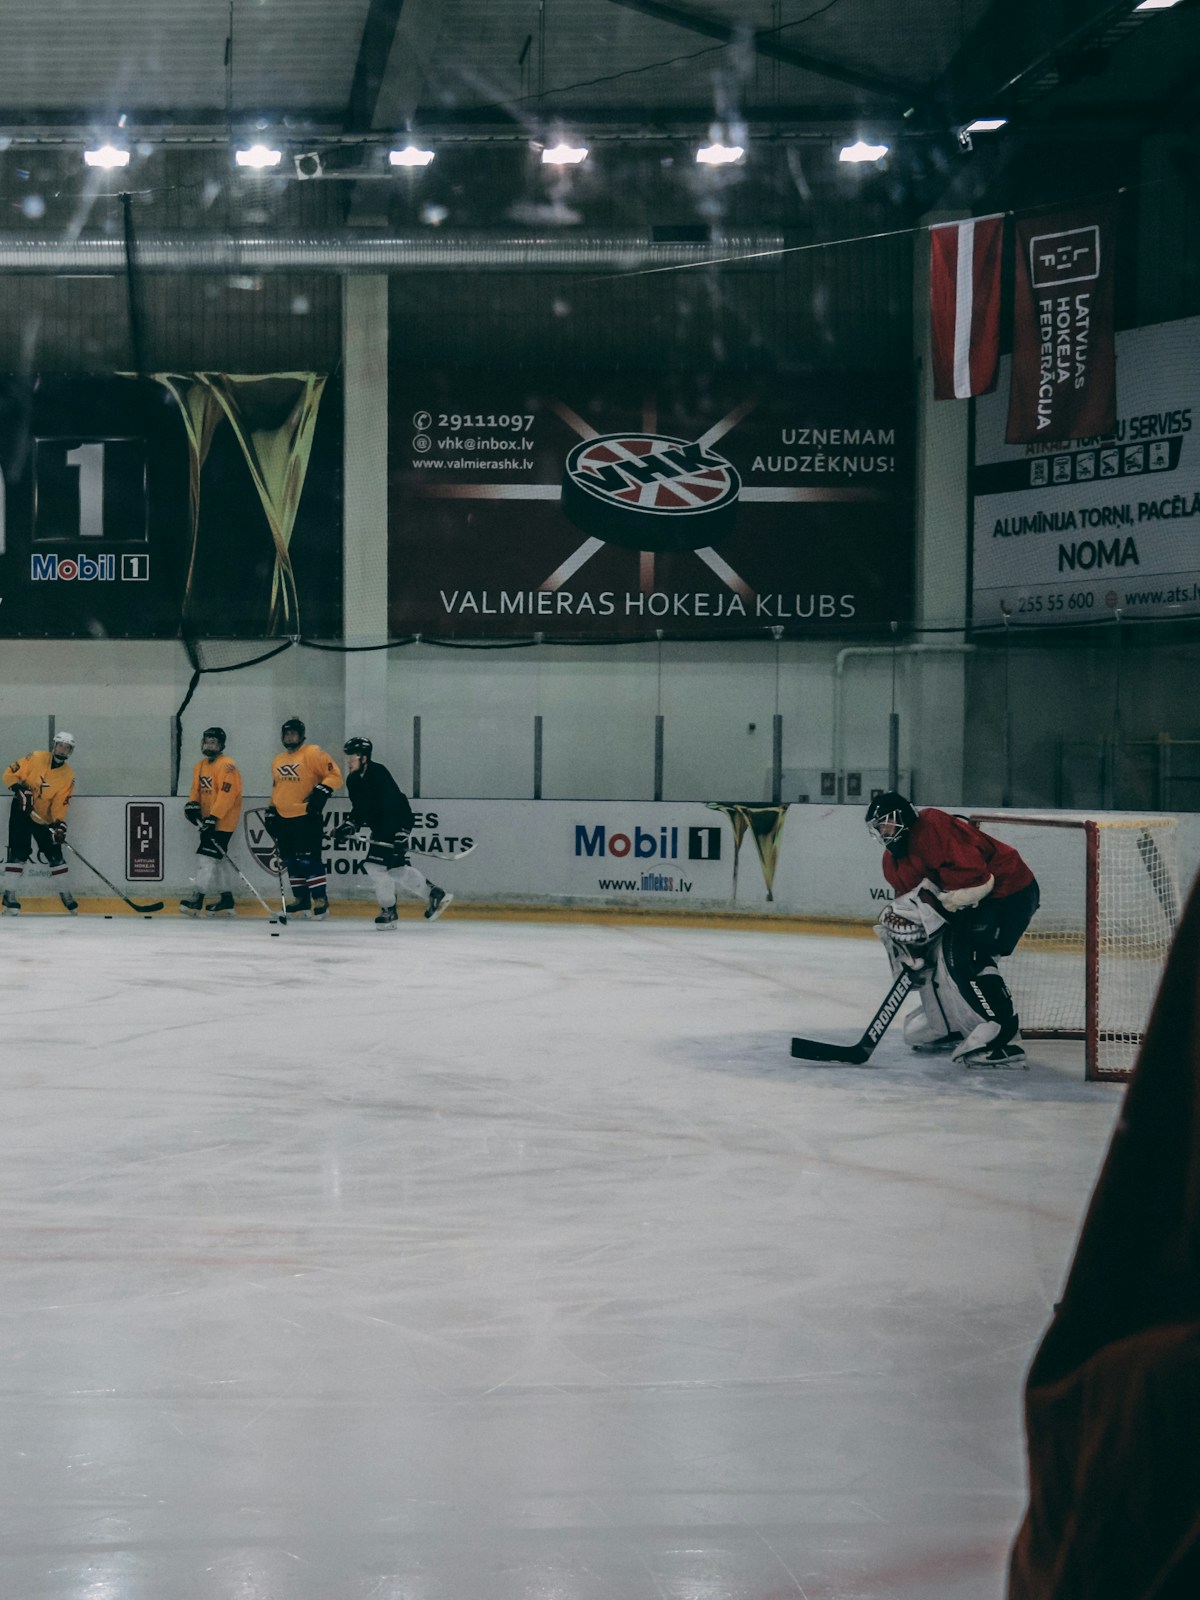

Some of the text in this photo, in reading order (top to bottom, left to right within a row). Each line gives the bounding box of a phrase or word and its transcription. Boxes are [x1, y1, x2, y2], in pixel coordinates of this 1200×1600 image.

[1056, 296, 1071, 384] HOKEJA
[1074, 293, 1090, 389] LATVIJAS
[1036, 299, 1055, 431] FEDERĀCIJA
[437, 413, 536, 432] 29111097
[1129, 408, 1192, 440] SERVISS
[437, 436, 535, 451] vhk@inbox.lv
[781, 428, 896, 450] UZŅEMAM
[412, 457, 534, 470] www.valmierashk.lv
[572, 442, 730, 493] VHK
[751, 452, 895, 477] AUDZĒKŅUS!
[66, 442, 105, 537] 1
[30, 553, 115, 581] Mobil
[1058, 537, 1139, 572] NOMA
[439, 589, 857, 618] VALMIERAS HOKEJA KLUBS
[1018, 592, 1095, 613] 255 55 600
[1125, 583, 1200, 605] www.ats.l
[575, 825, 678, 859] Mobil
[598, 871, 693, 893] www.inflekss.lv
[868, 972, 913, 1043] FRONTIER
